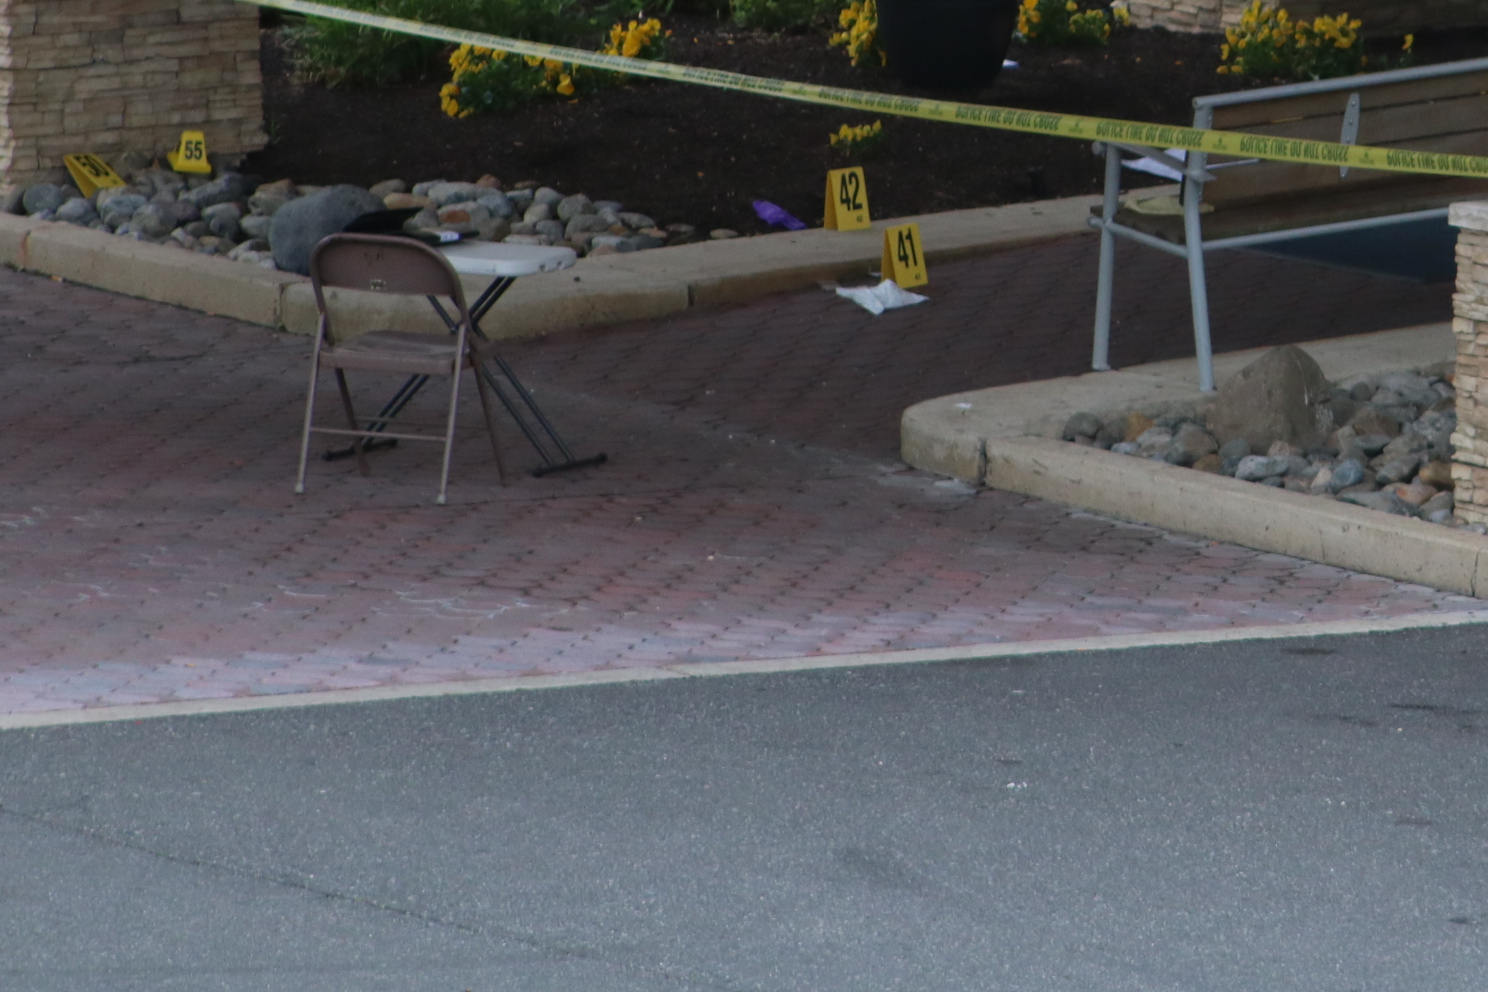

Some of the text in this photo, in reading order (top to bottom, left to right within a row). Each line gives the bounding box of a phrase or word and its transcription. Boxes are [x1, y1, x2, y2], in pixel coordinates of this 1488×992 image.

[184, 140, 203, 161] 55
[840, 171, 863, 212] 42
[897, 227, 918, 268] 41
